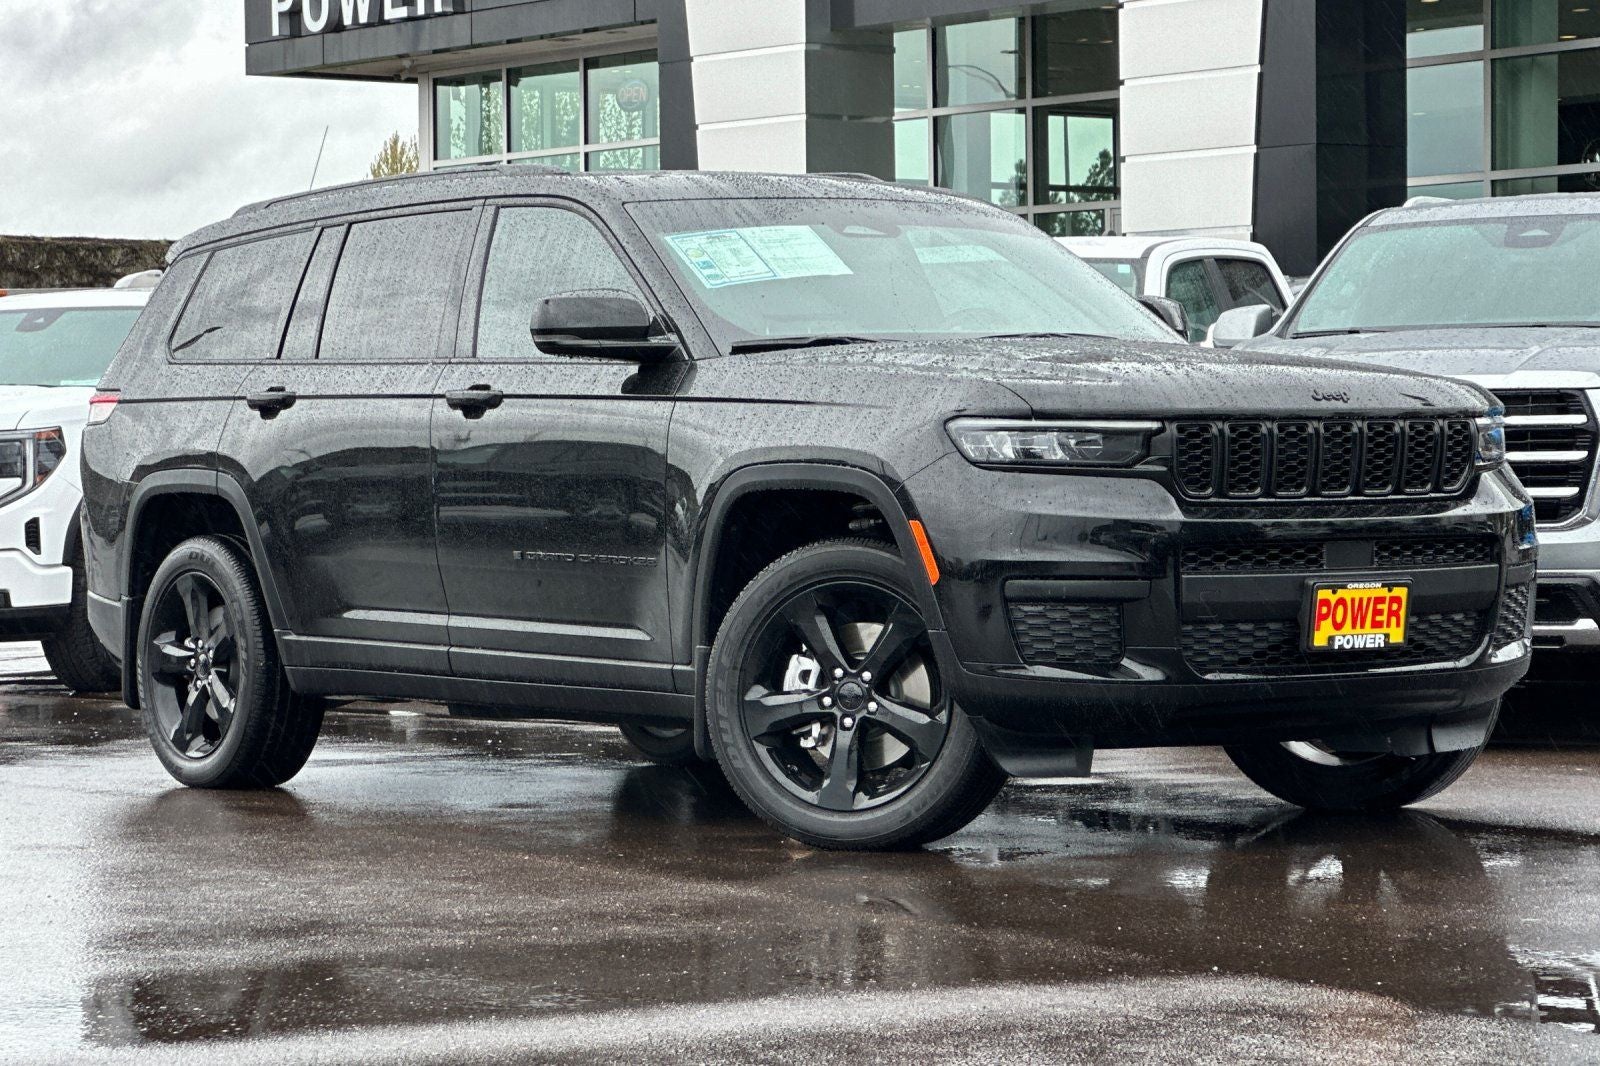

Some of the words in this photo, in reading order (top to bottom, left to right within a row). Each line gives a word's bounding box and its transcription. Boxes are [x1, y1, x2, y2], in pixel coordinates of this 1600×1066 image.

[618, 86, 646, 102] OPEN
[1311, 389, 1350, 403] Jeep
[1315, 596, 1403, 631] POWER
[1334, 634, 1385, 649] POWER
